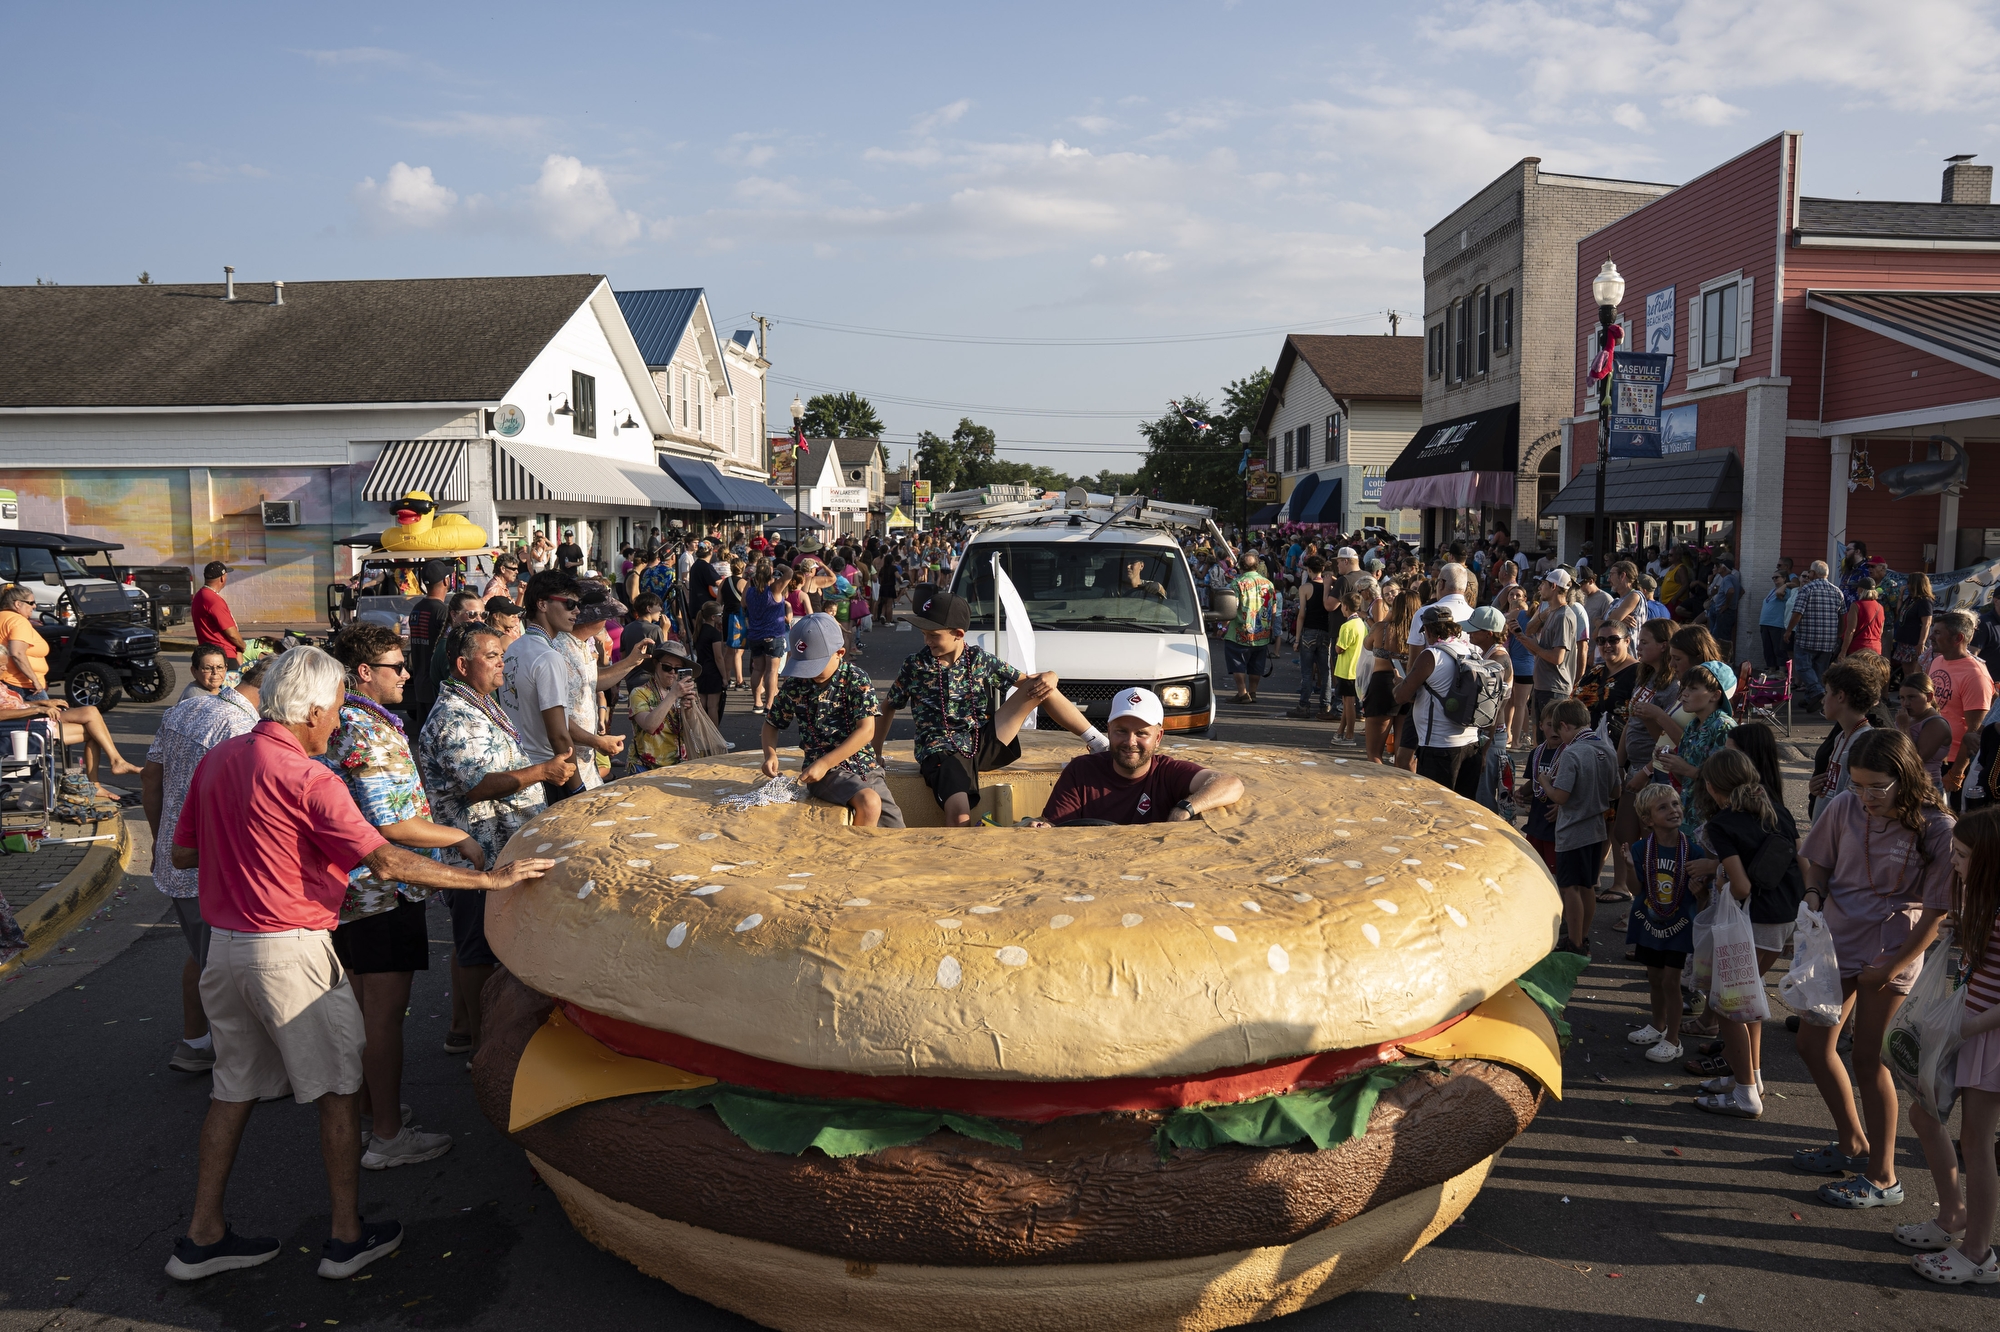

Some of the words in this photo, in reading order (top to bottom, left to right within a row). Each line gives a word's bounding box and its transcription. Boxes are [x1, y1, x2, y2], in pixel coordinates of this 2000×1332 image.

[1618, 364, 1661, 375] CASEVILLE
[1614, 417, 1635, 425] SPELL
[1644, 418, 1658, 426] OUT!
[1669, 442, 1692, 453] YOGURT
[1364, 488, 1382, 497] outfi
[1634, 910, 1646, 920] UP
[1643, 919, 1652, 931] TO
[1651, 917, 1689, 938] SOMETHING
[1729, 941, 1751, 955] YOU
[1732, 953, 1753, 967] YOU
[1734, 966, 1754, 980] YOU
[1891, 1032, 1919, 1070] Hollywood
